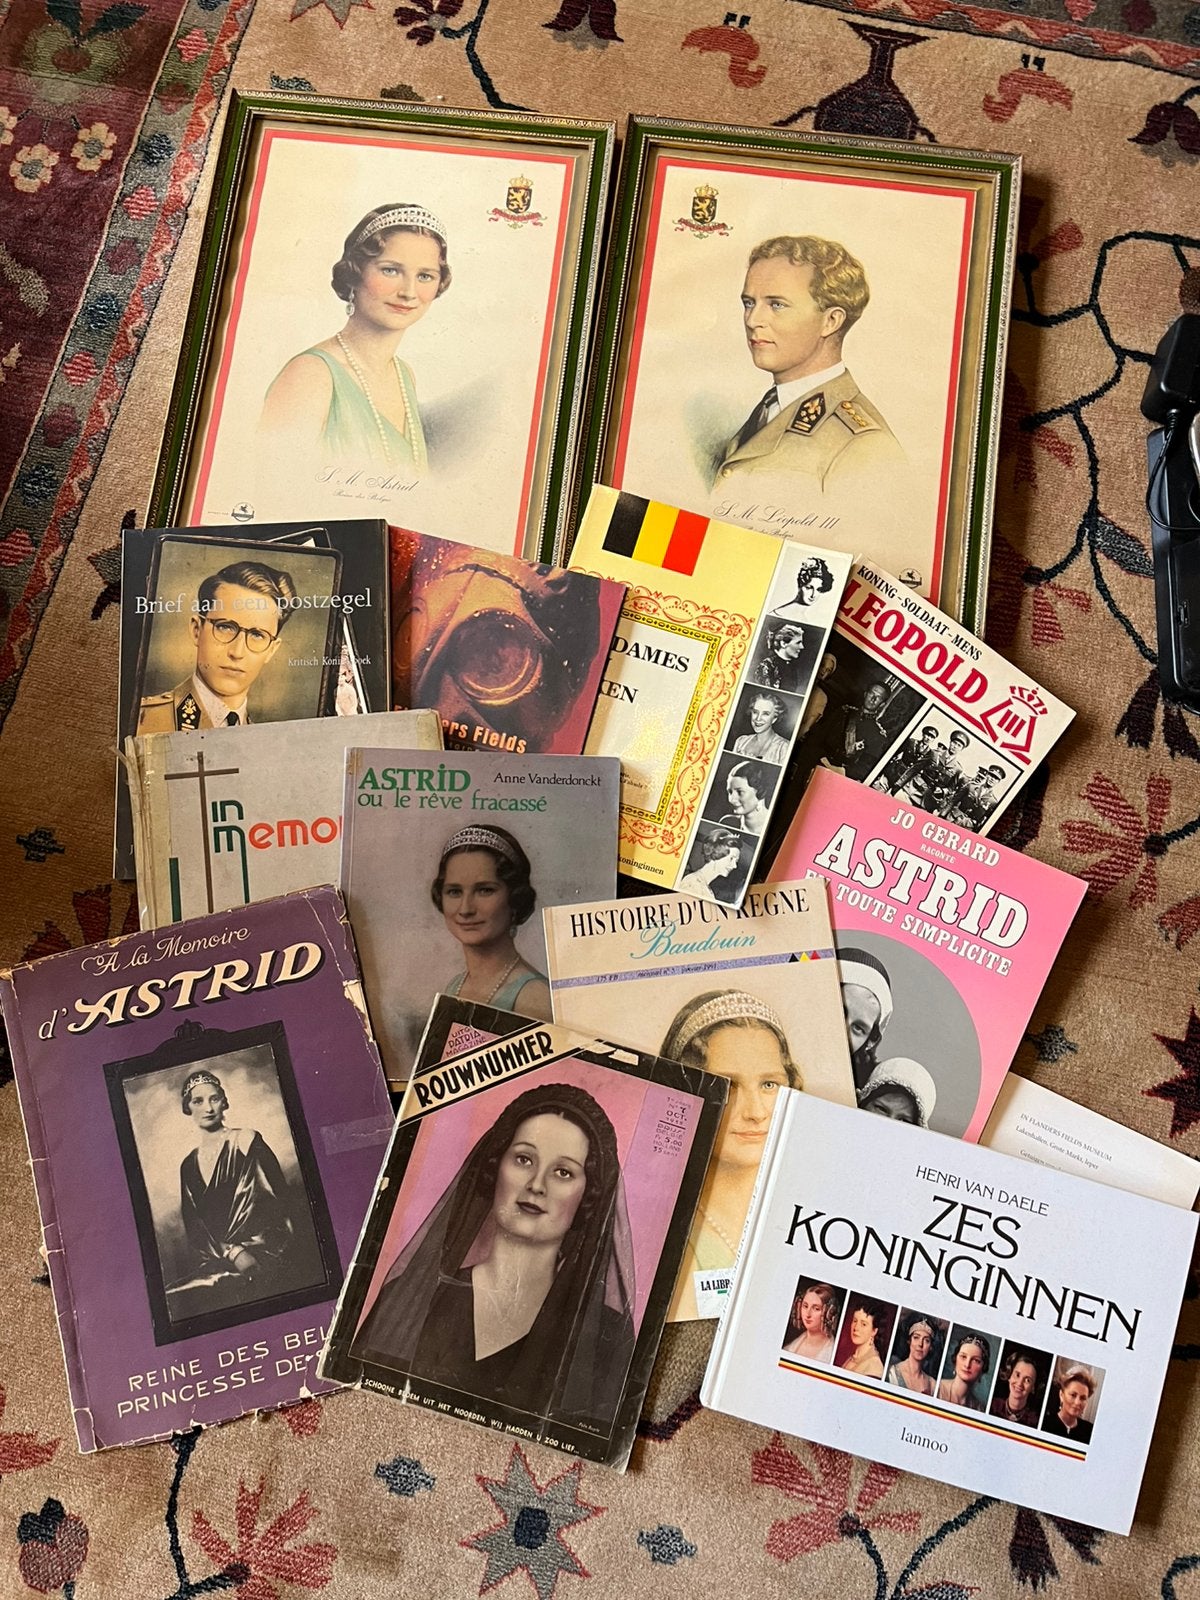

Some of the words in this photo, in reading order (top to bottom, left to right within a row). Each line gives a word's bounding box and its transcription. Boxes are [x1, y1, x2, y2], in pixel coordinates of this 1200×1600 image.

[365, 474, 420, 491] Astrid
[758, 505, 819, 529] Léopold
[819, 517, 841, 529] III
[135, 593, 187, 615] Brief
[191, 599, 225, 613] aan
[233, 597, 270, 612] een
[276, 588, 372, 617] postzegel
[857, 565, 898, 599] KONING
[901, 598, 950, 637] SOLDAAT
[951, 634, 983, 661] MENS
[288, 656, 319, 667] Kritisch
[611, 635, 691, 673] DAMES
[838, 578, 989, 704] LEOPOLD
[997, 709, 1026, 738] III
[473, 725, 527, 754] Fields
[357, 793, 383, 808] ou
[393, 787, 411, 809] le
[418, 791, 463, 810] rêve
[471, 789, 548, 812] fracassé
[493, 772, 526, 785] Anne
[528, 773, 603, 787] Vanderdonckt
[889, 808, 917, 830] JO
[921, 821, 1001, 868] GERARD
[919, 843, 957, 865] RACONTE
[812, 822, 1029, 949] ASTRID
[570, 902, 674, 938] HISTOIRE
[677, 899, 729, 926] D'UN
[630, 920, 757, 960] Baudouin
[836, 882, 899, 925] TOUTE
[900, 914, 1013, 978] SIMPLICITE
[81, 951, 120, 977] A
[121, 945, 152, 967] la
[154, 926, 252, 962] Memoire
[38, 941, 323, 1040] d'ASTRID
[413, 1031, 554, 1108] ROUWNUMMER
[446, 1036, 487, 1057] MAGAZINE
[1020, 1113, 1030, 1121] IN
[1029, 1116, 1062, 1137] FLANDERS
[1061, 1131, 1083, 1147] FIELDS
[1083, 1143, 1113, 1162] MUSEUM
[916, 1165, 962, 1190] HENRI
[965, 1178, 996, 1201] VAN
[998, 1189, 1051, 1217] DAELE
[922, 1195, 1022, 1260] ZES
[700, 1280, 712, 1292] LA
[784, 1203, 1143, 1351] KONINGINNEN
[117, 1365, 265, 1418] PRINCESSE
[275, 1354, 307, 1377] DE
[128, 1358, 203, 1392] REINE
[218, 1340, 270, 1369] DES
[364, 1378, 396, 1394] SCHOONE
[423, 1397, 436, 1407] UIT
[438, 1403, 452, 1412] HET
[490, 1419, 503, 1430] WIJ
[506, 1424, 533, 1438] HADDEN
[544, 1436, 559, 1447] ZOO
[900, 1426, 949, 1456] lannoo
